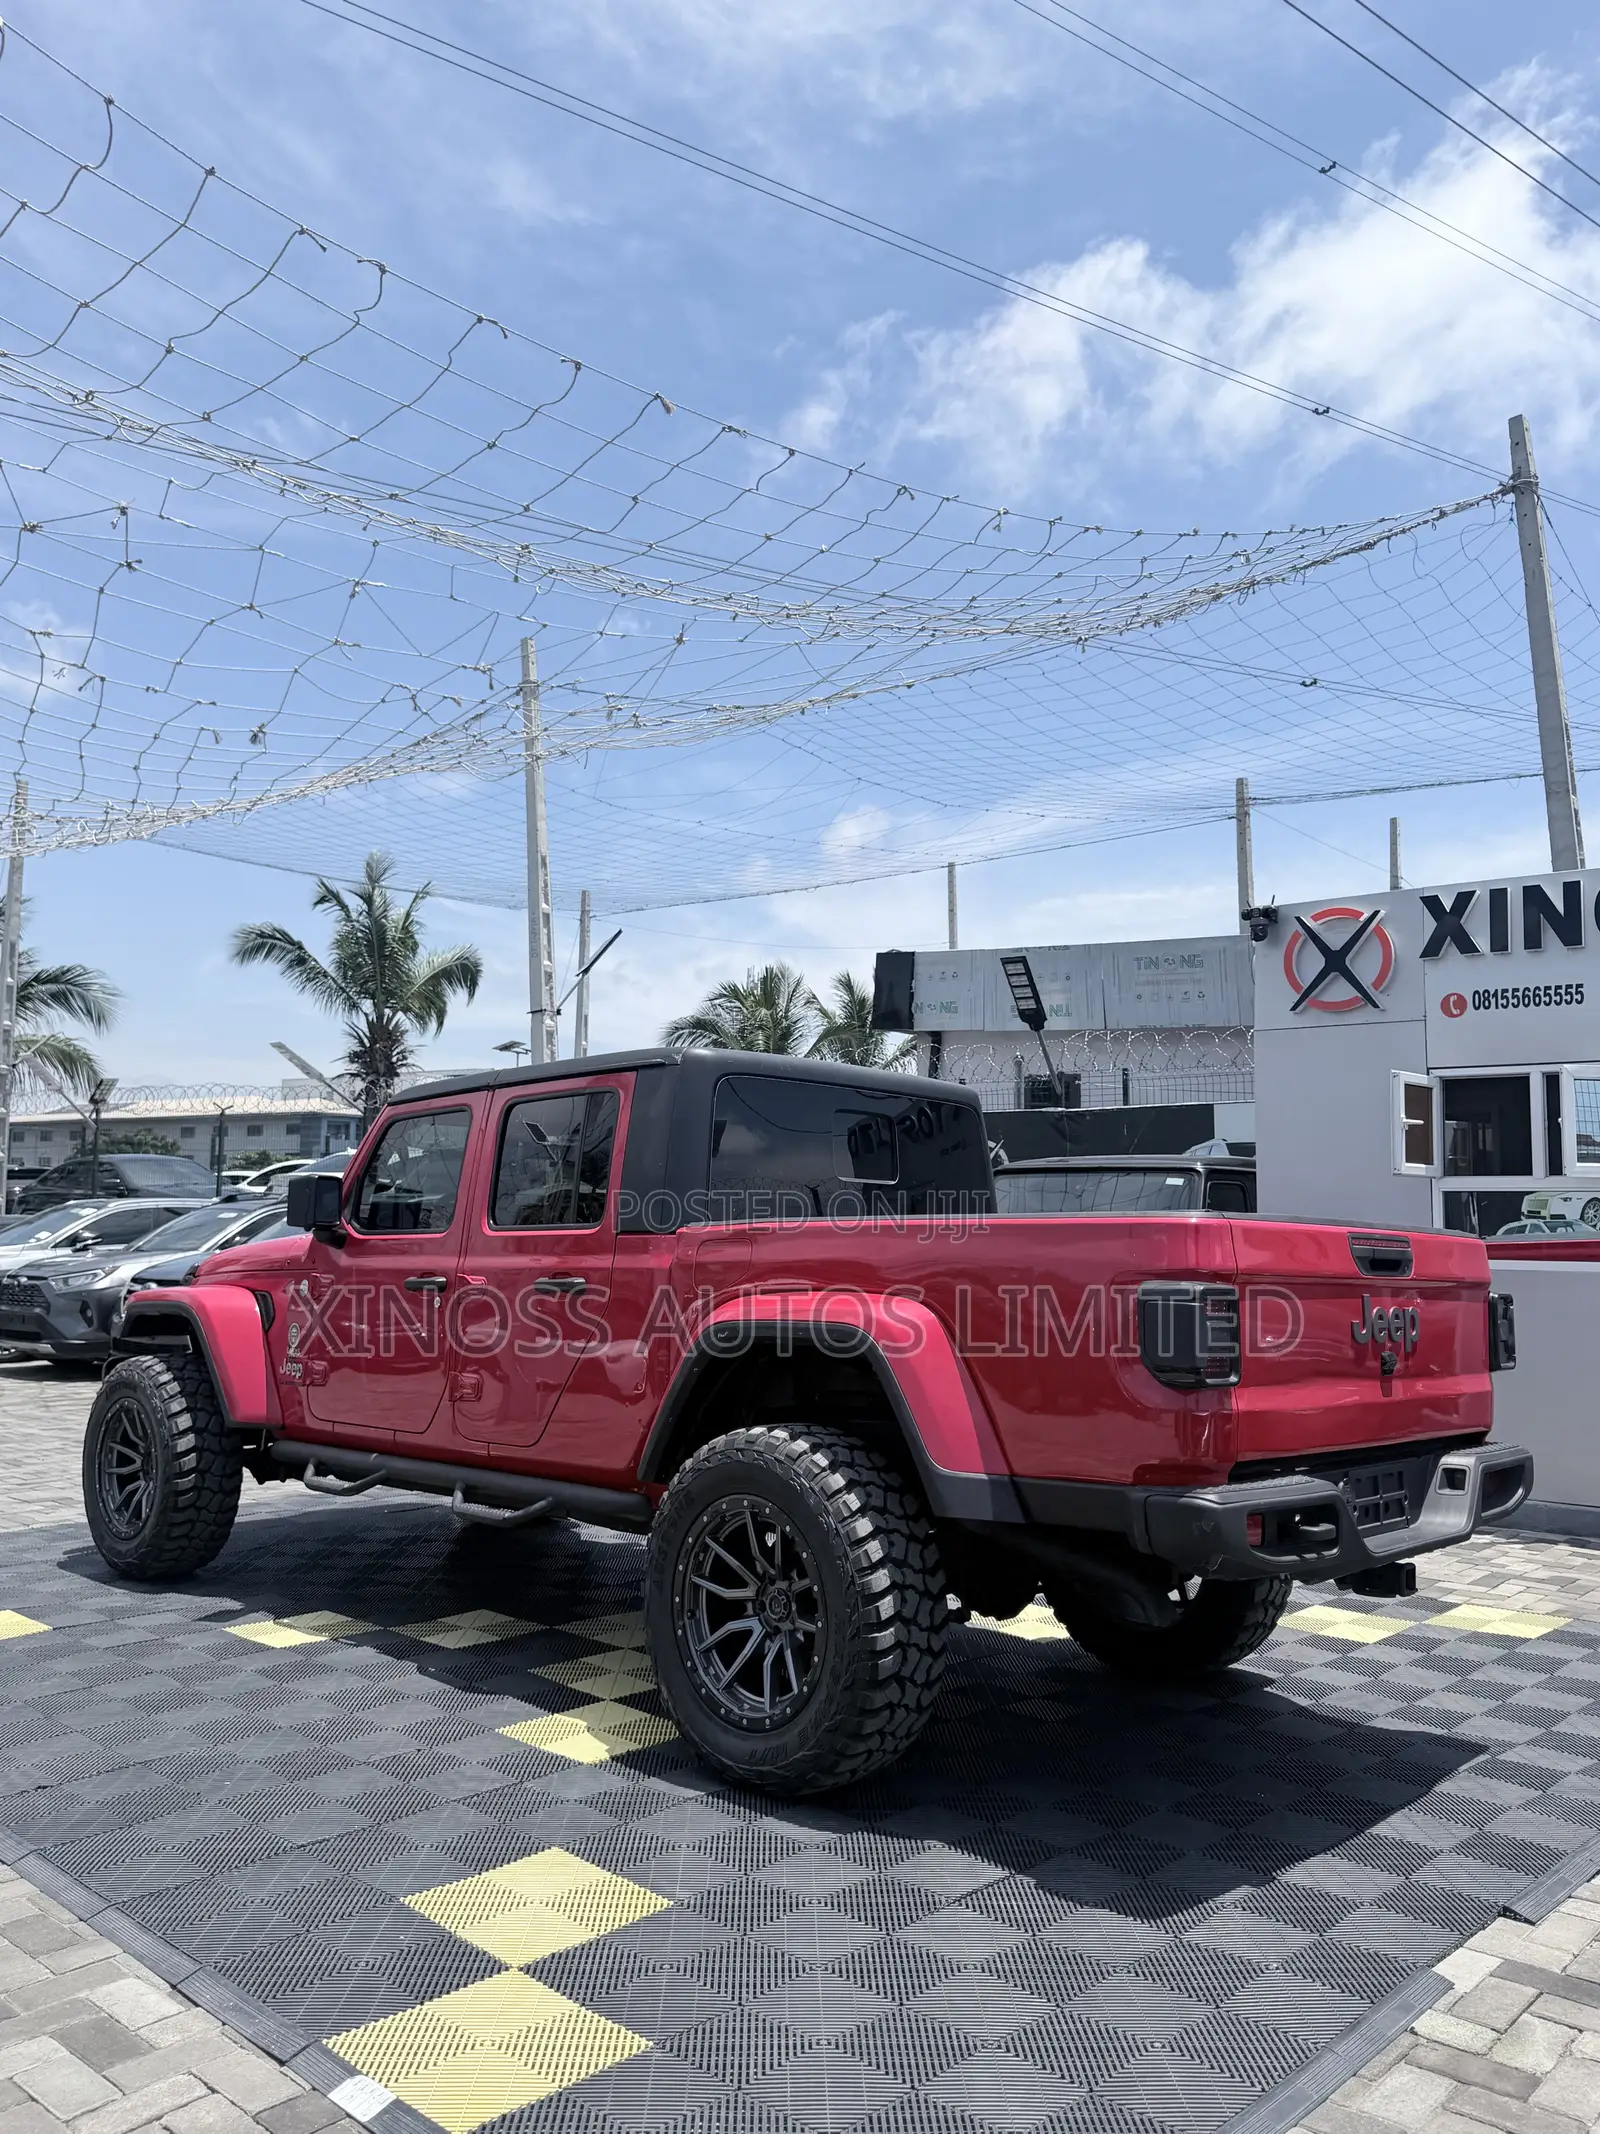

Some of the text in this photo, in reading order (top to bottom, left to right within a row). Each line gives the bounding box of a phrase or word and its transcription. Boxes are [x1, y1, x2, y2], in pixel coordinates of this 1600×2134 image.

[1418, 879, 1600, 960] XIN
[1472, 983, 1585, 1011] 08155665555
[1350, 1293, 1419, 1353] Jeep
[280, 1359, 303, 1379] Jeep
